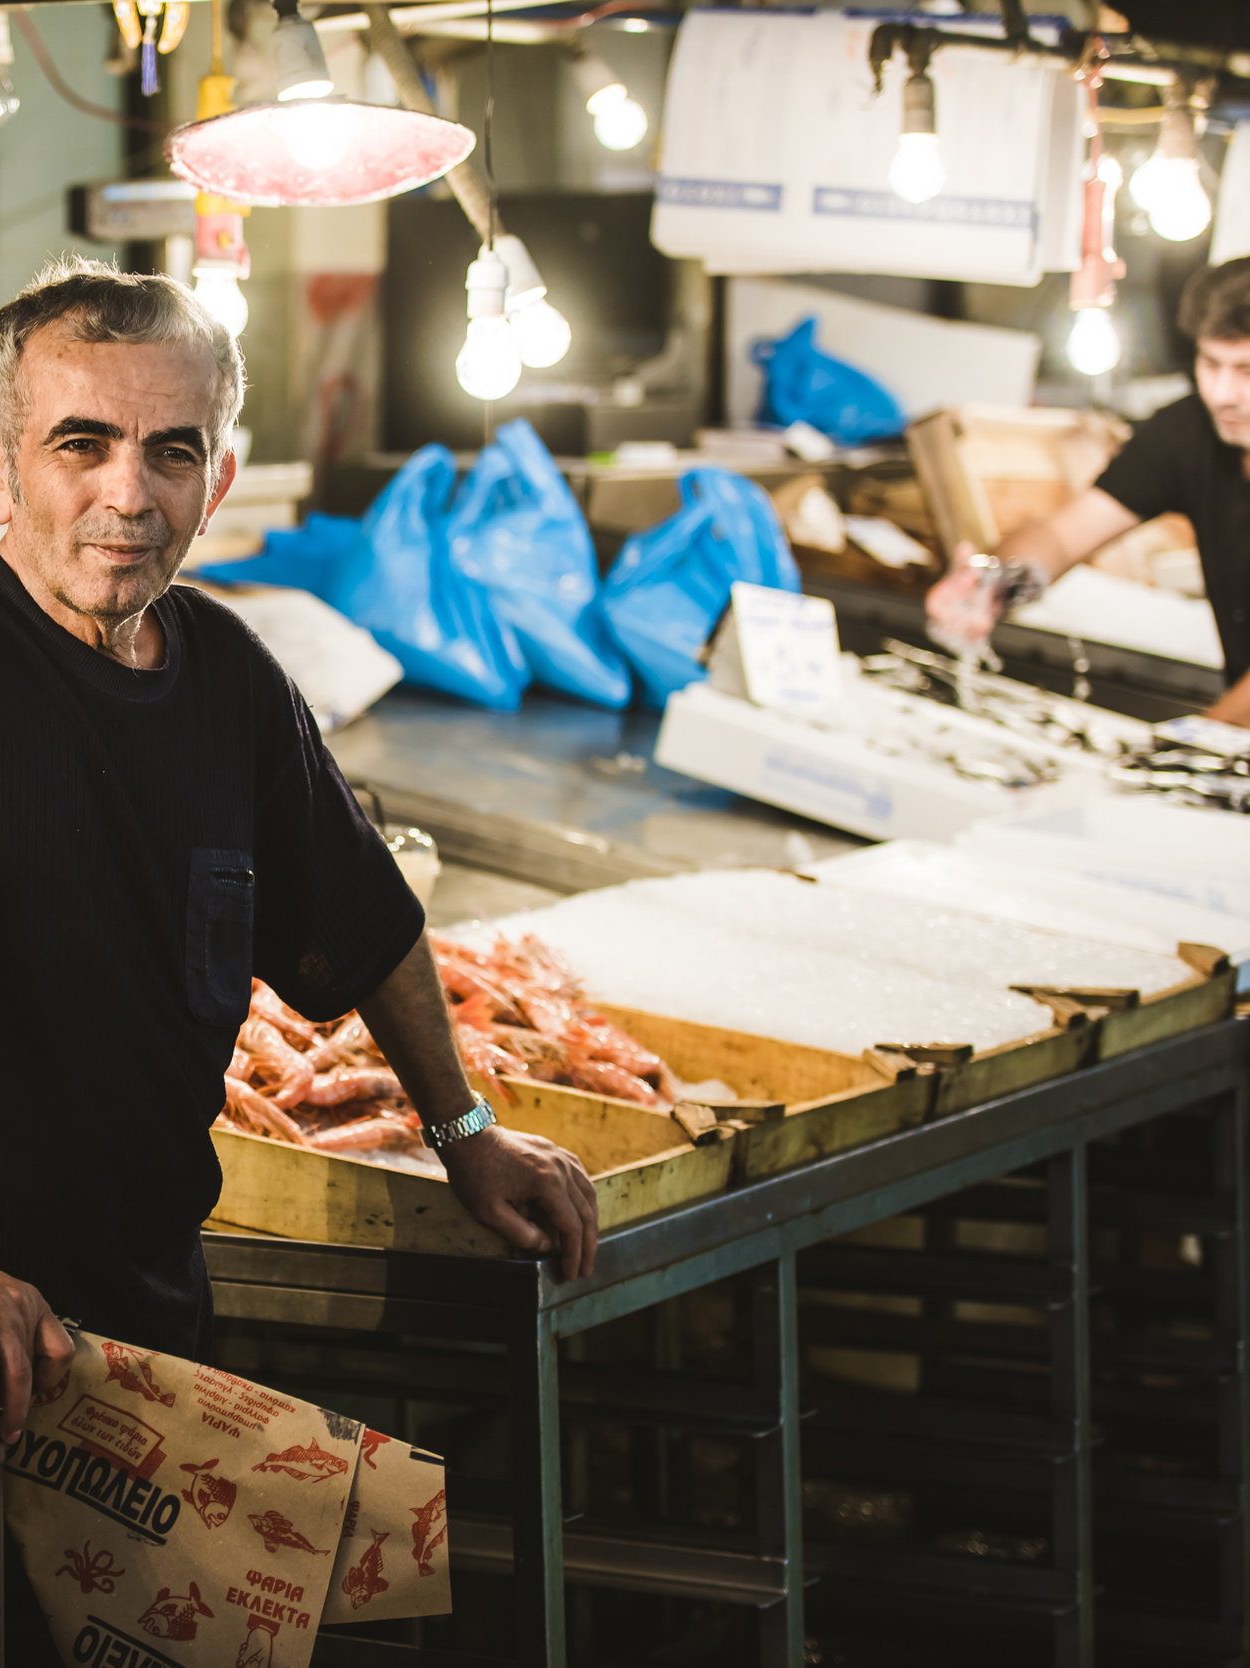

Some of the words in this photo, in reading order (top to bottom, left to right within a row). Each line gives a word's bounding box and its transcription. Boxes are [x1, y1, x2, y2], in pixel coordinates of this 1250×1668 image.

[201, 1412, 240, 1439] ΨΑΡΙΑ
[6, 1430, 180, 1535] ΥΟΠΩΛΕΙΟ
[246, 1569, 304, 1603] ΨΑΡΙΑ
[225, 1586, 311, 1629] ΕΚΛΕΚΤΑ
